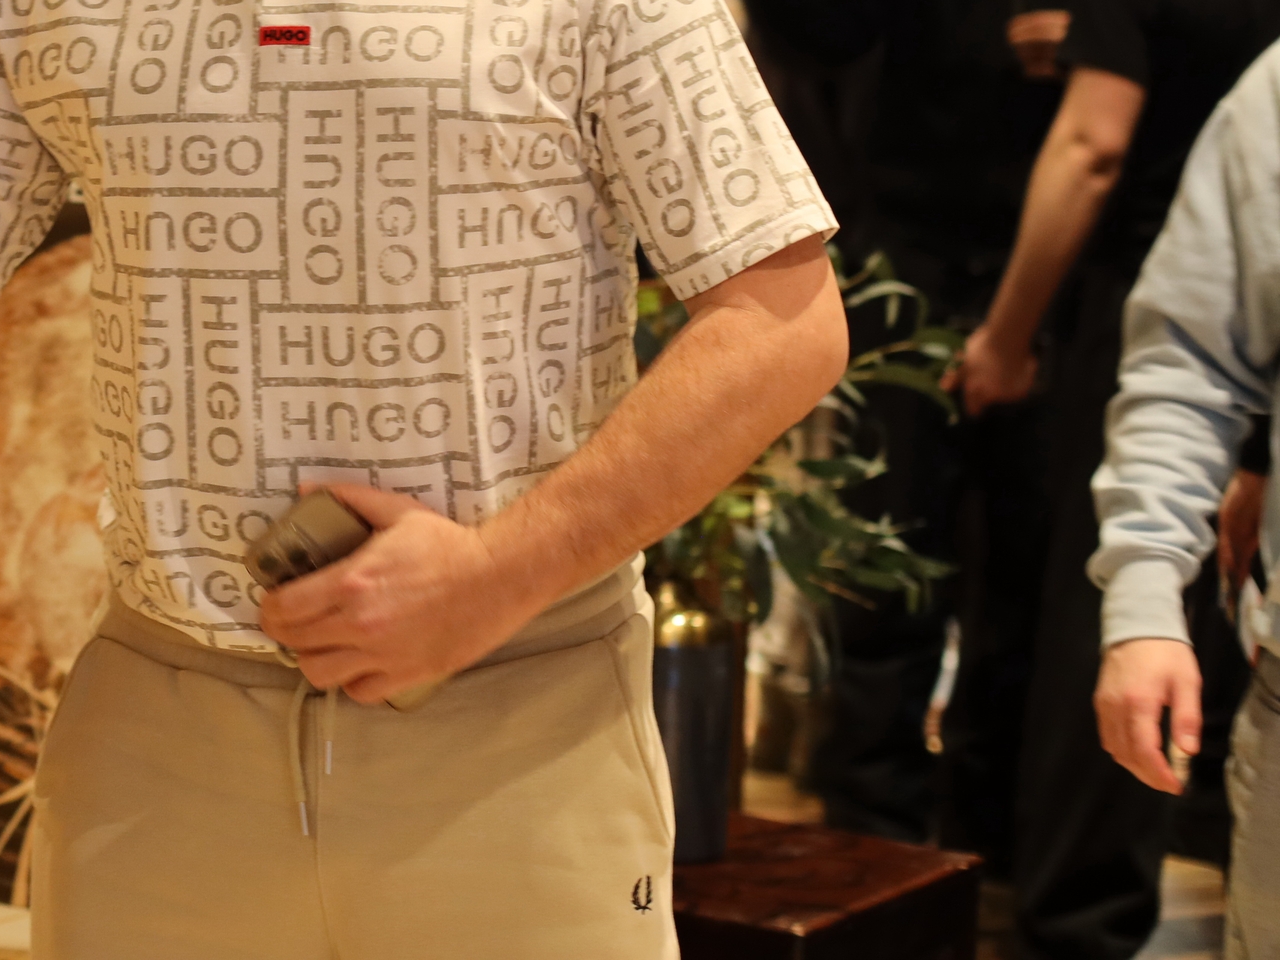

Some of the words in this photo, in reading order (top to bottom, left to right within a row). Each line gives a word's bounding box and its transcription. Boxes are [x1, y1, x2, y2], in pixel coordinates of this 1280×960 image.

[263, 27, 309, 43] HUGO
[104, 134, 264, 177] HUGO
[375, 106, 418, 287] HUGO
[674, 45, 761, 208] HUGO
[200, 295, 244, 467] HUGO
[278, 322, 447, 368] HUGO
[536, 275, 573, 442] HUGO
